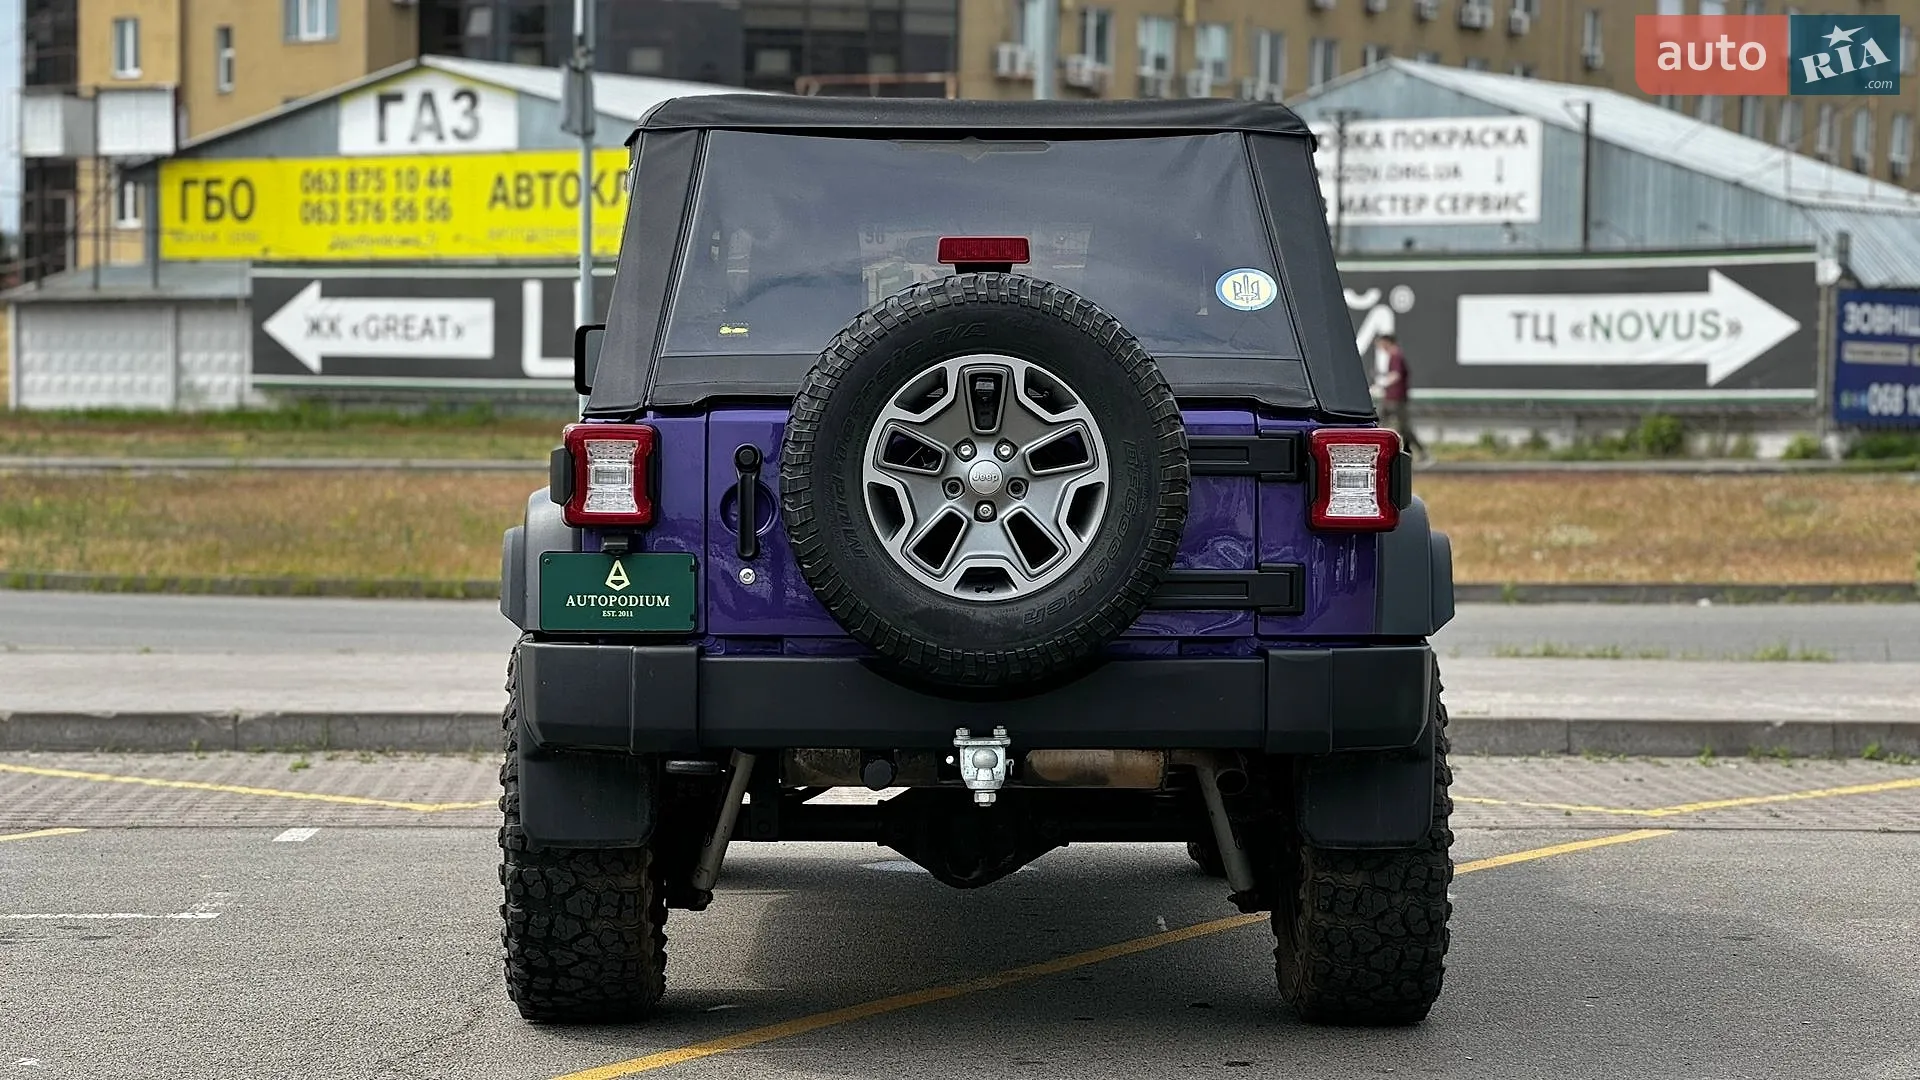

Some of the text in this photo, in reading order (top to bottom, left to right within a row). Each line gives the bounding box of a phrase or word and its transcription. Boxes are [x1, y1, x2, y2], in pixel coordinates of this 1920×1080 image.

[377, 88, 480, 143] ГАЗ
[1317, 125, 1529, 149] ОВКА ПОКРАСКА
[300, 165, 452, 195] 063 875 10 44
[180, 176, 256, 223] ГБО
[300, 196, 452, 225] 063 576 56 56
[1434, 191, 1528, 215] СЕРВИС
[303, 312, 465, 342] ЖК «GREAT»
[1509, 309, 1743, 348] ТЦ «NOVUS»
[1867, 382, 1905, 417] 068
[972, 472, 999, 483] Jeep
[566, 594, 671, 607] AUTOPODIUM
